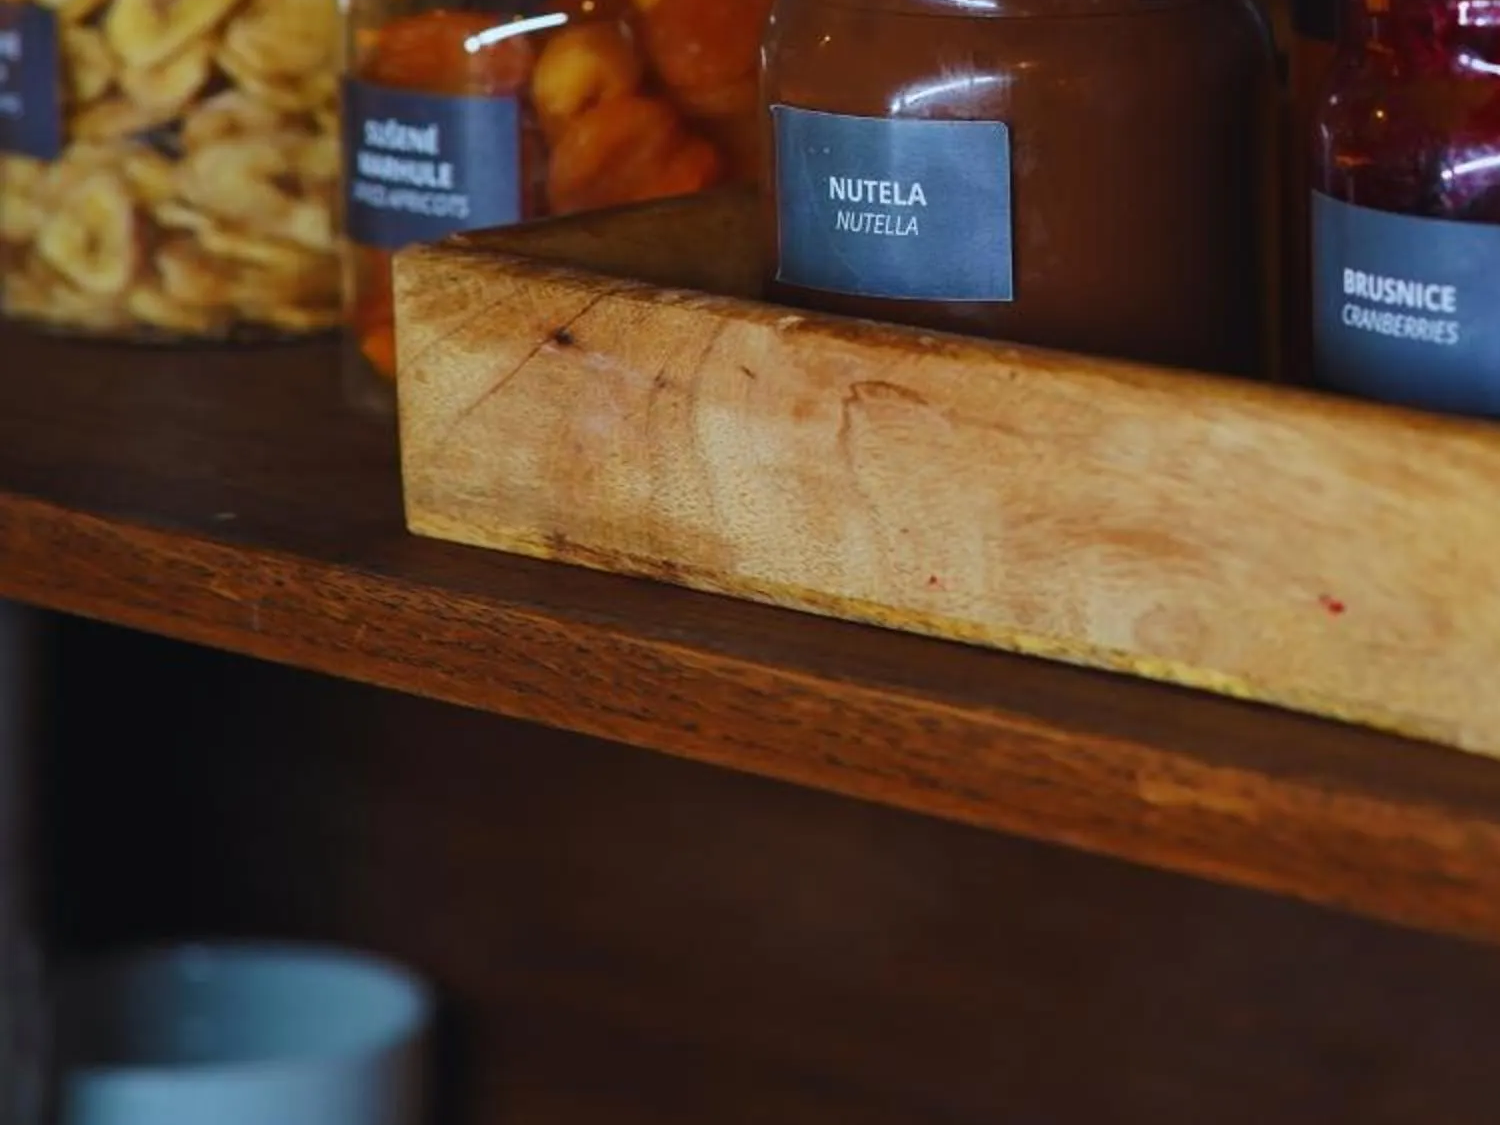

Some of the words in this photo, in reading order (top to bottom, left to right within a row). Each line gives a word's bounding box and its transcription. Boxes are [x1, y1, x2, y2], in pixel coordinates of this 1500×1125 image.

[828, 176, 927, 206] NUTELA
[835, 210, 919, 236] NUTELLA
[1343, 267, 1457, 313] BRUSNICE
[1342, 303, 1460, 346] CRANBERRIES
